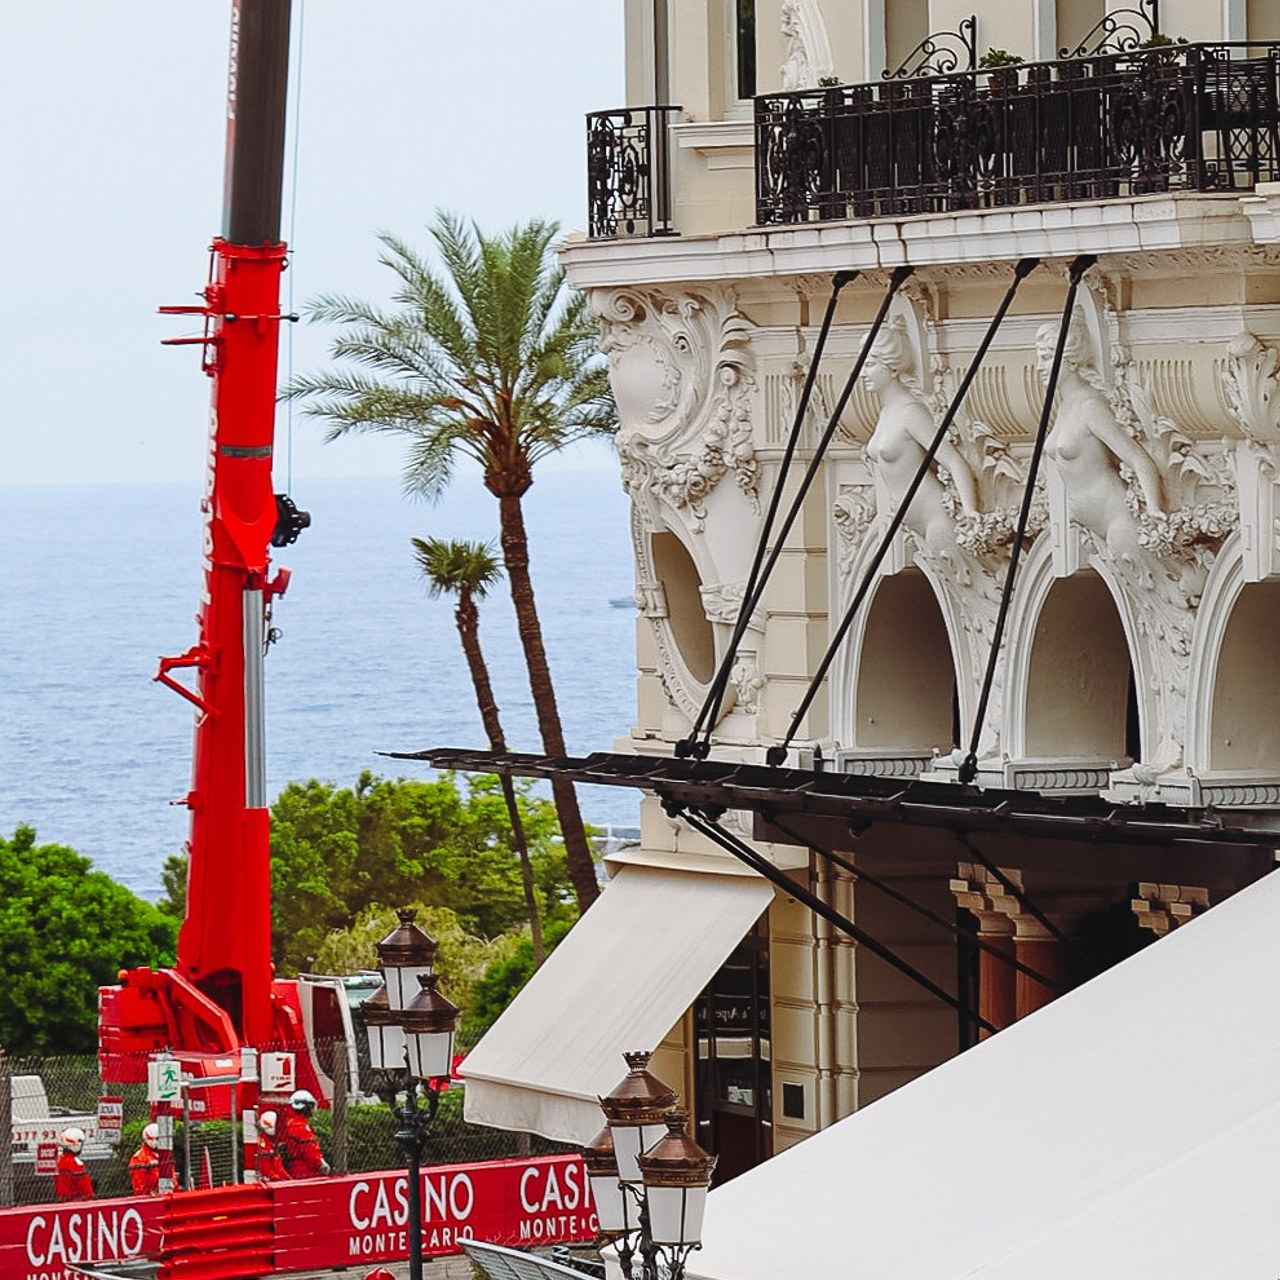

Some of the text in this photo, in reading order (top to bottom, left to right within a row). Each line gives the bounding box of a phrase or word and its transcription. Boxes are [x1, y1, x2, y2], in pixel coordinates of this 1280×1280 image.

[349, 1172, 474, 1231] CASNO
[520, 1215, 577, 1240] MONTE
[26, 1208, 144, 1267] CASINO
